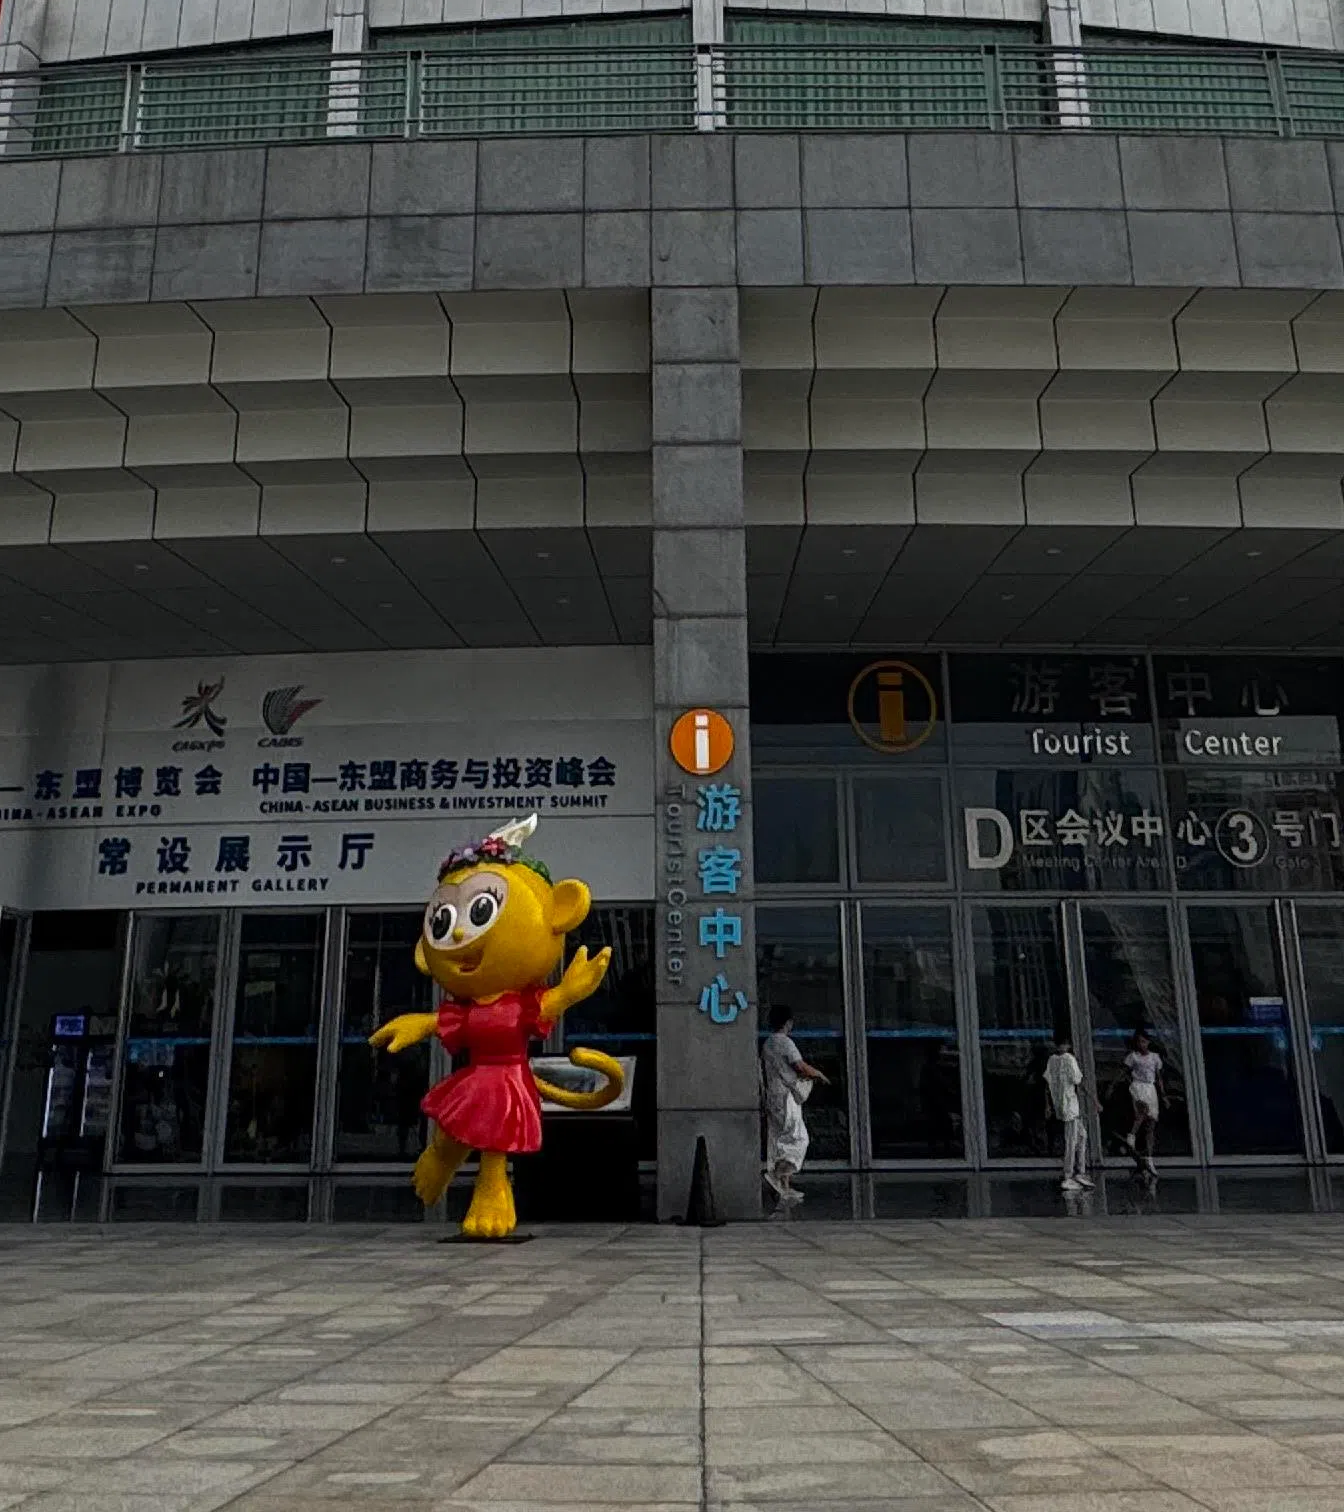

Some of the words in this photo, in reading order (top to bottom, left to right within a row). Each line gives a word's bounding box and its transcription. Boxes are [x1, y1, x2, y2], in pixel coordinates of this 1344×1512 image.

[1011, 662, 1290, 717] 游客中心
[1032, 728, 1132, 756] Tourist
[1185, 729, 1283, 757] Center
[116, 805, 162, 818] EXPO
[364, 796, 436, 812] BUSINESS
[452, 795, 545, 810] INVESTMENT
[550, 794, 608, 809] SUMMIT
[98, 833, 375, 876] 常设展示厅
[135, 879, 239, 895] PERMANENT
[251, 878, 330, 892] GALLERY
[696, 783, 748, 1024] 游客中心
